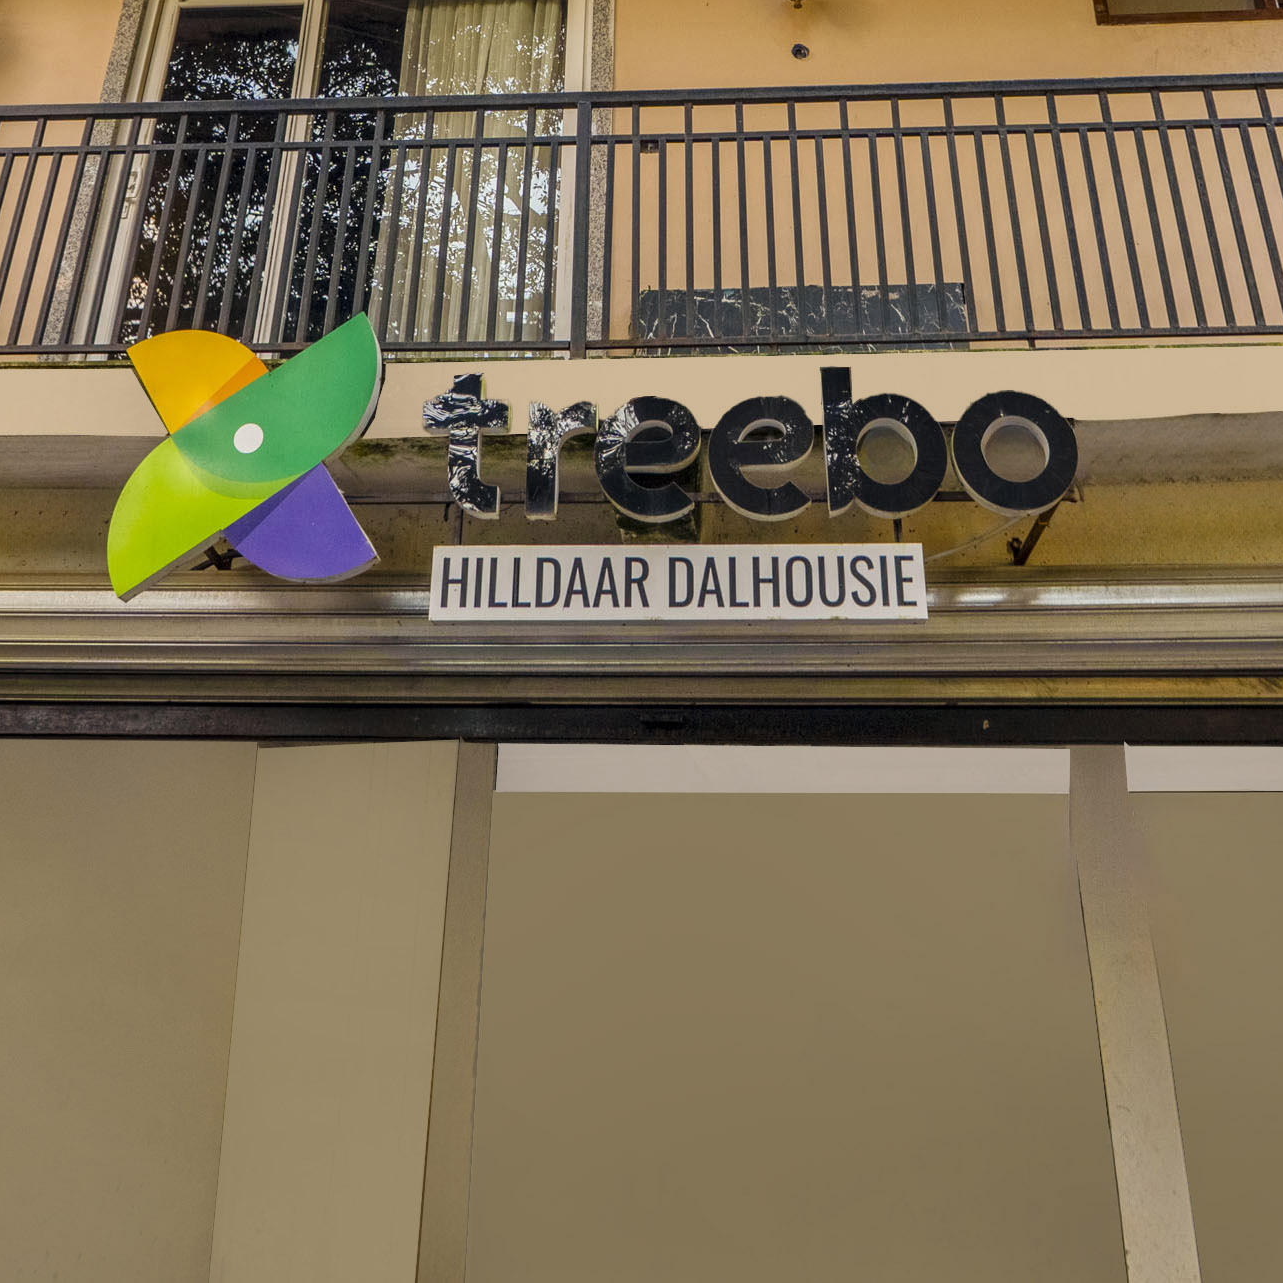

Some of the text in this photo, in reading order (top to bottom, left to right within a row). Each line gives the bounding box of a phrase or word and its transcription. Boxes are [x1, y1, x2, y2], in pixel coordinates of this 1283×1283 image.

[422, 366, 1078, 522] treebo
[439, 555, 918, 608] HILLDAAR DALHOUSIE
